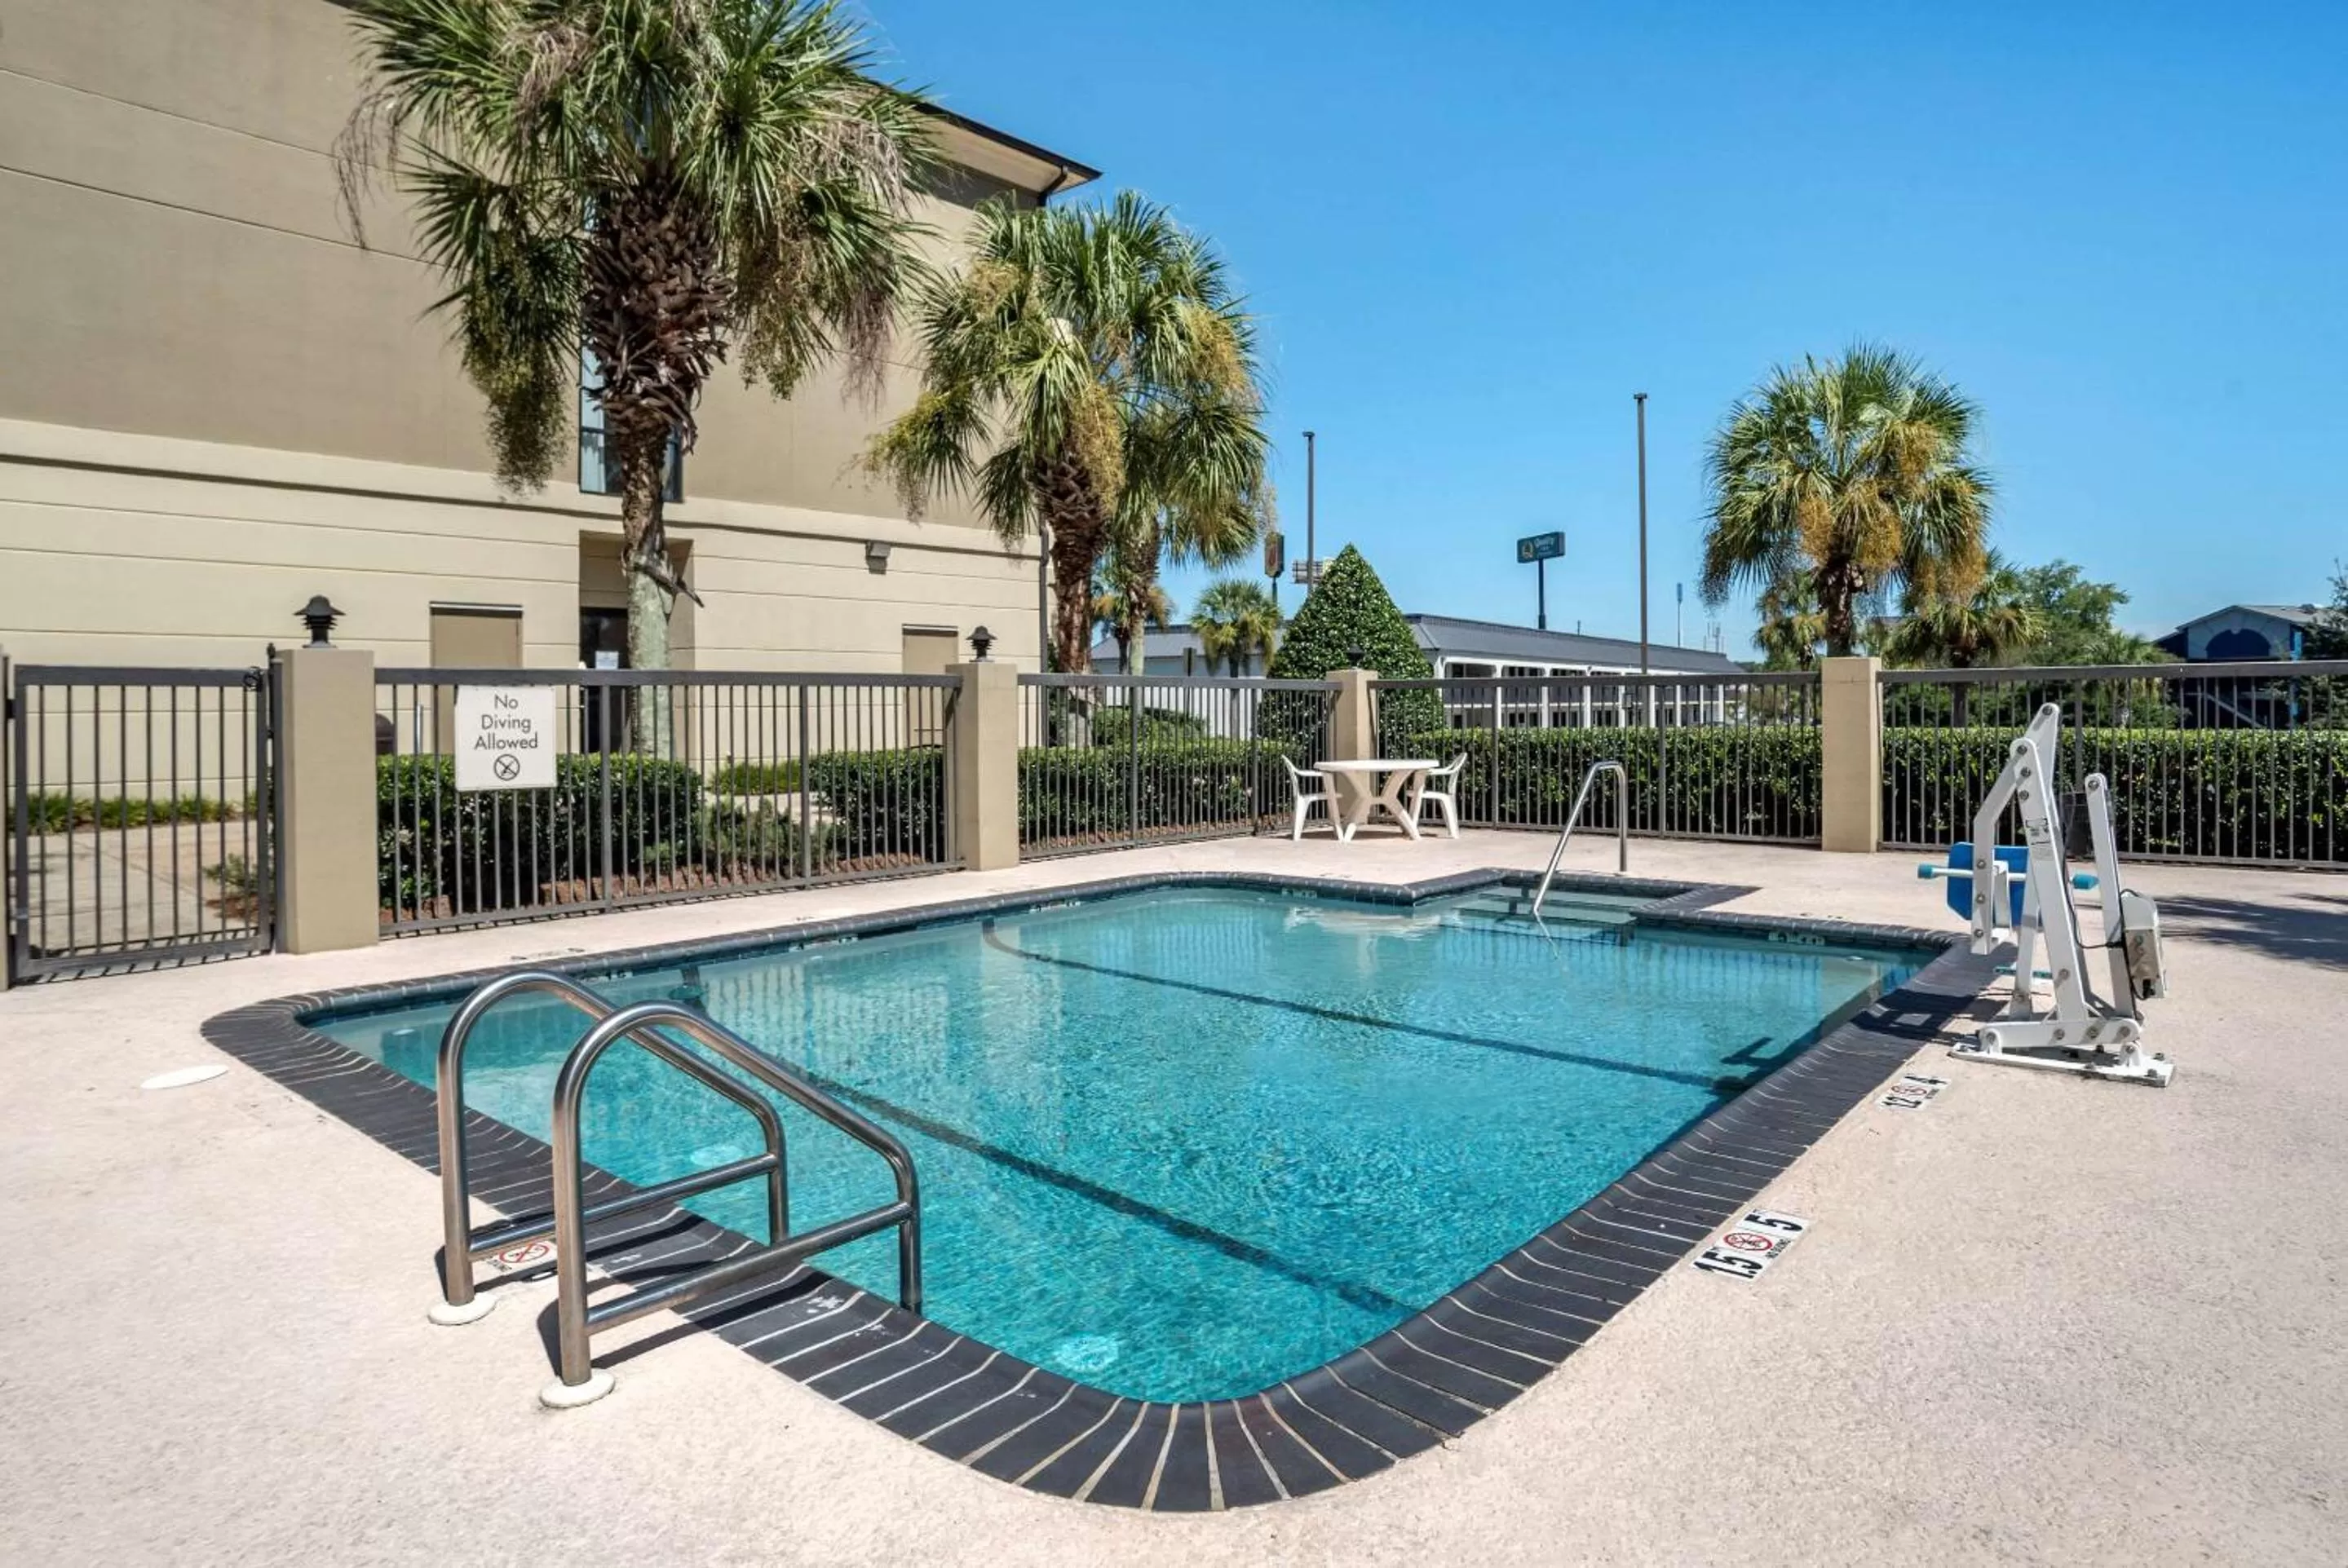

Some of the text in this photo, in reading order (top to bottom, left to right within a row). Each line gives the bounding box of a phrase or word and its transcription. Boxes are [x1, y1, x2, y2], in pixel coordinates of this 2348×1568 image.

[494, 693, 518, 709] No
[481, 714, 531, 733] Diving
[474, 731, 538, 750] Allowed
[1744, 1214, 1802, 1231] 5
